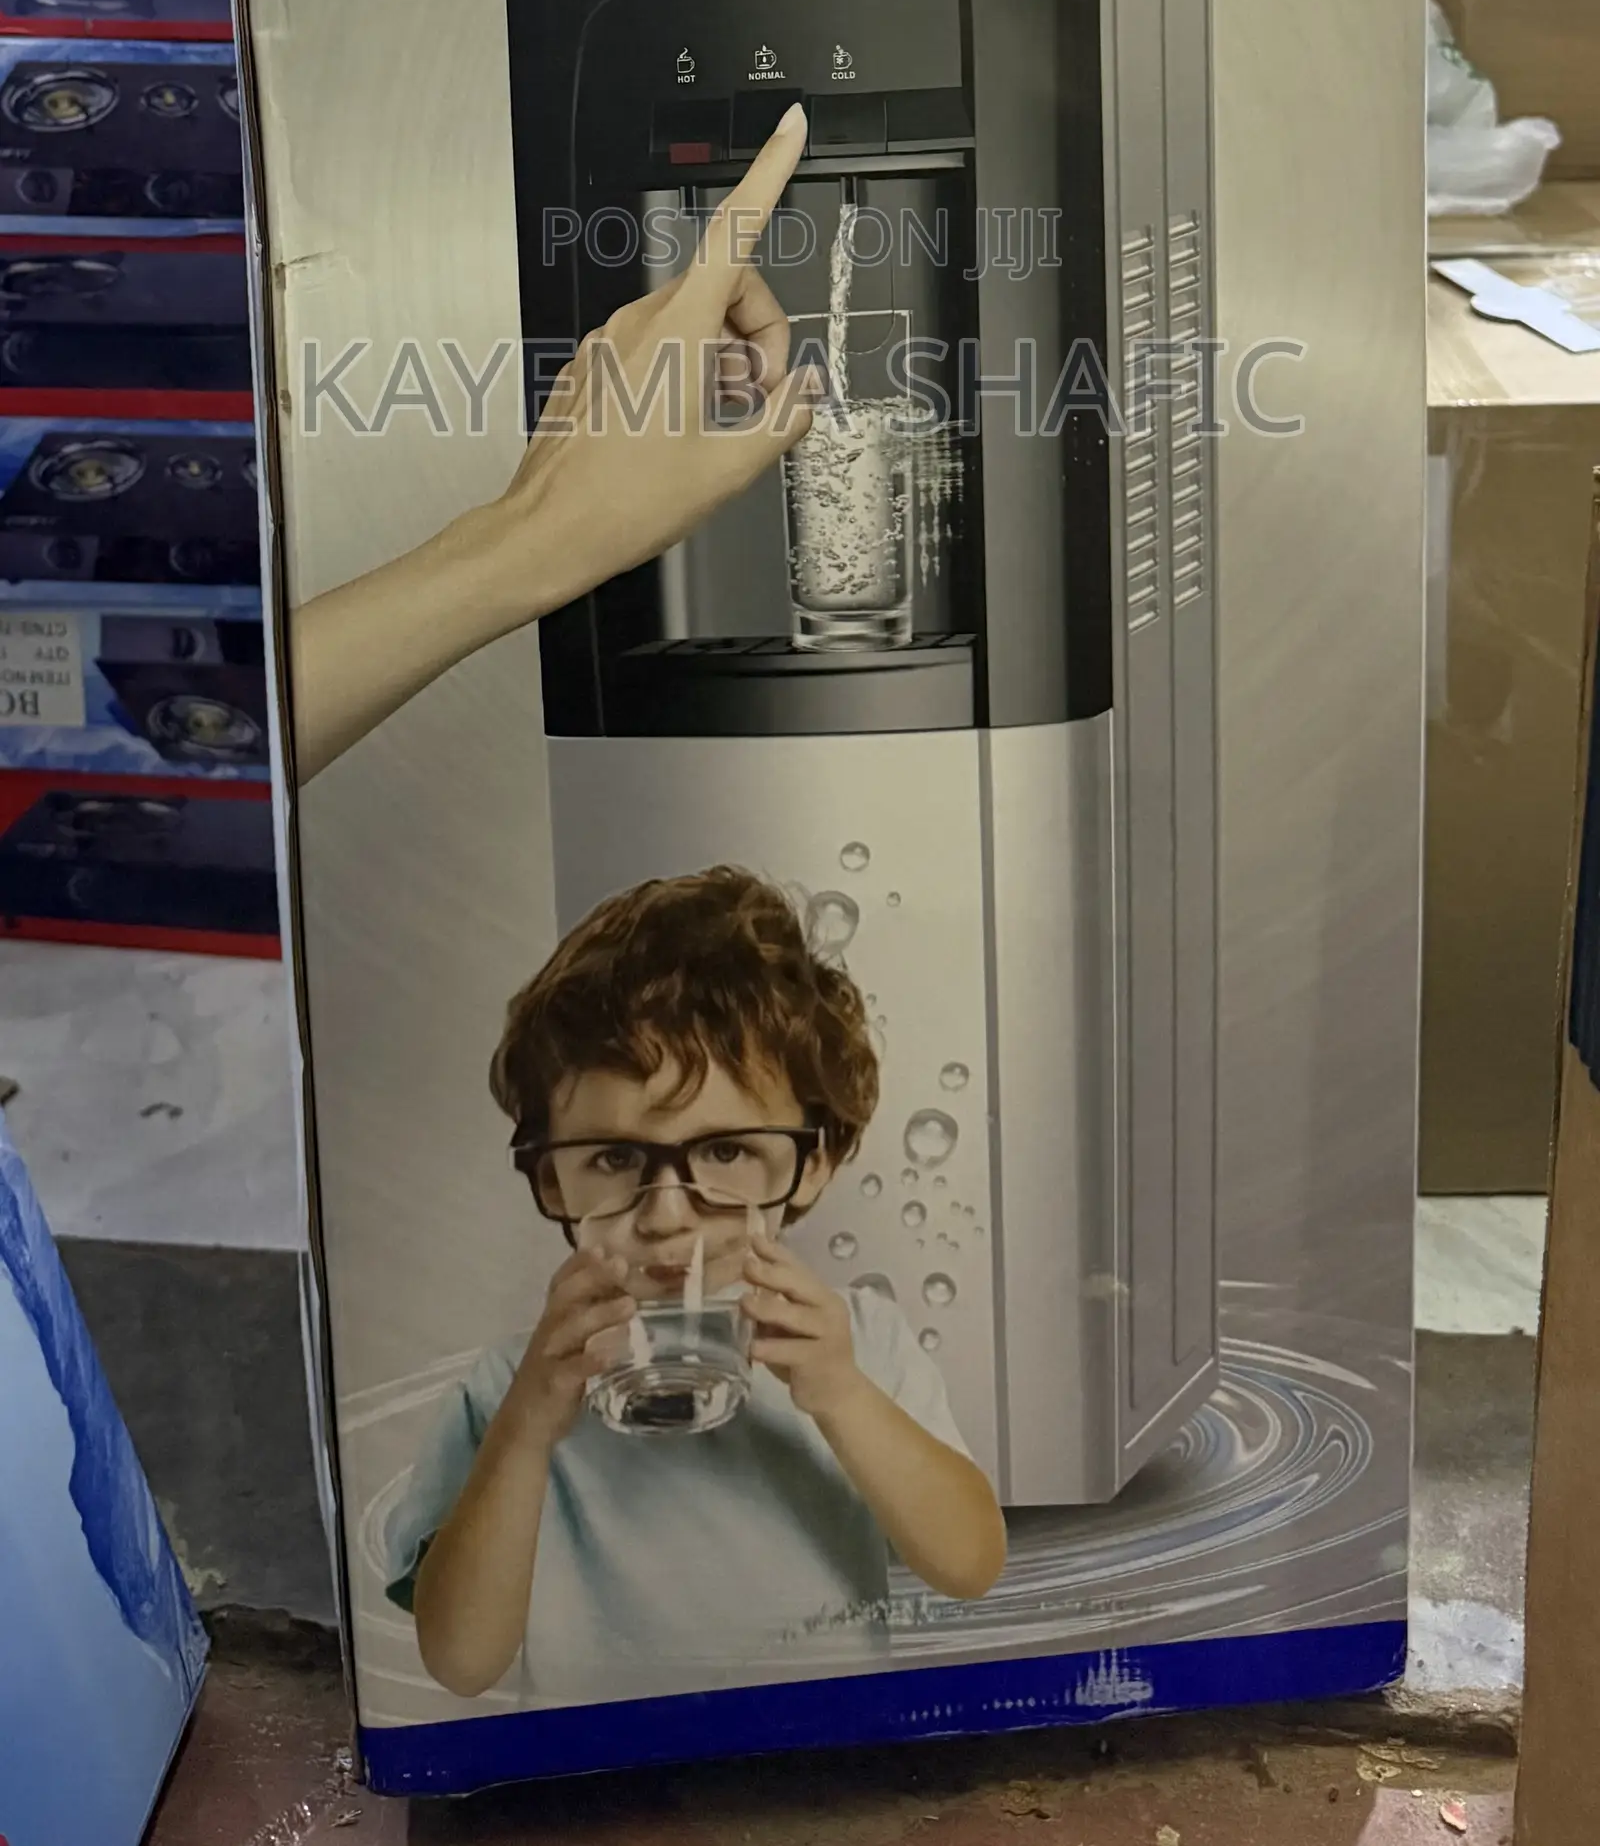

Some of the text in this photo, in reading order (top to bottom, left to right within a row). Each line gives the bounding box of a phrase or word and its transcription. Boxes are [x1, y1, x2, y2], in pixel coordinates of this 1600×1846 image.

[677, 71, 856, 83] HOT NORMAL COLD
